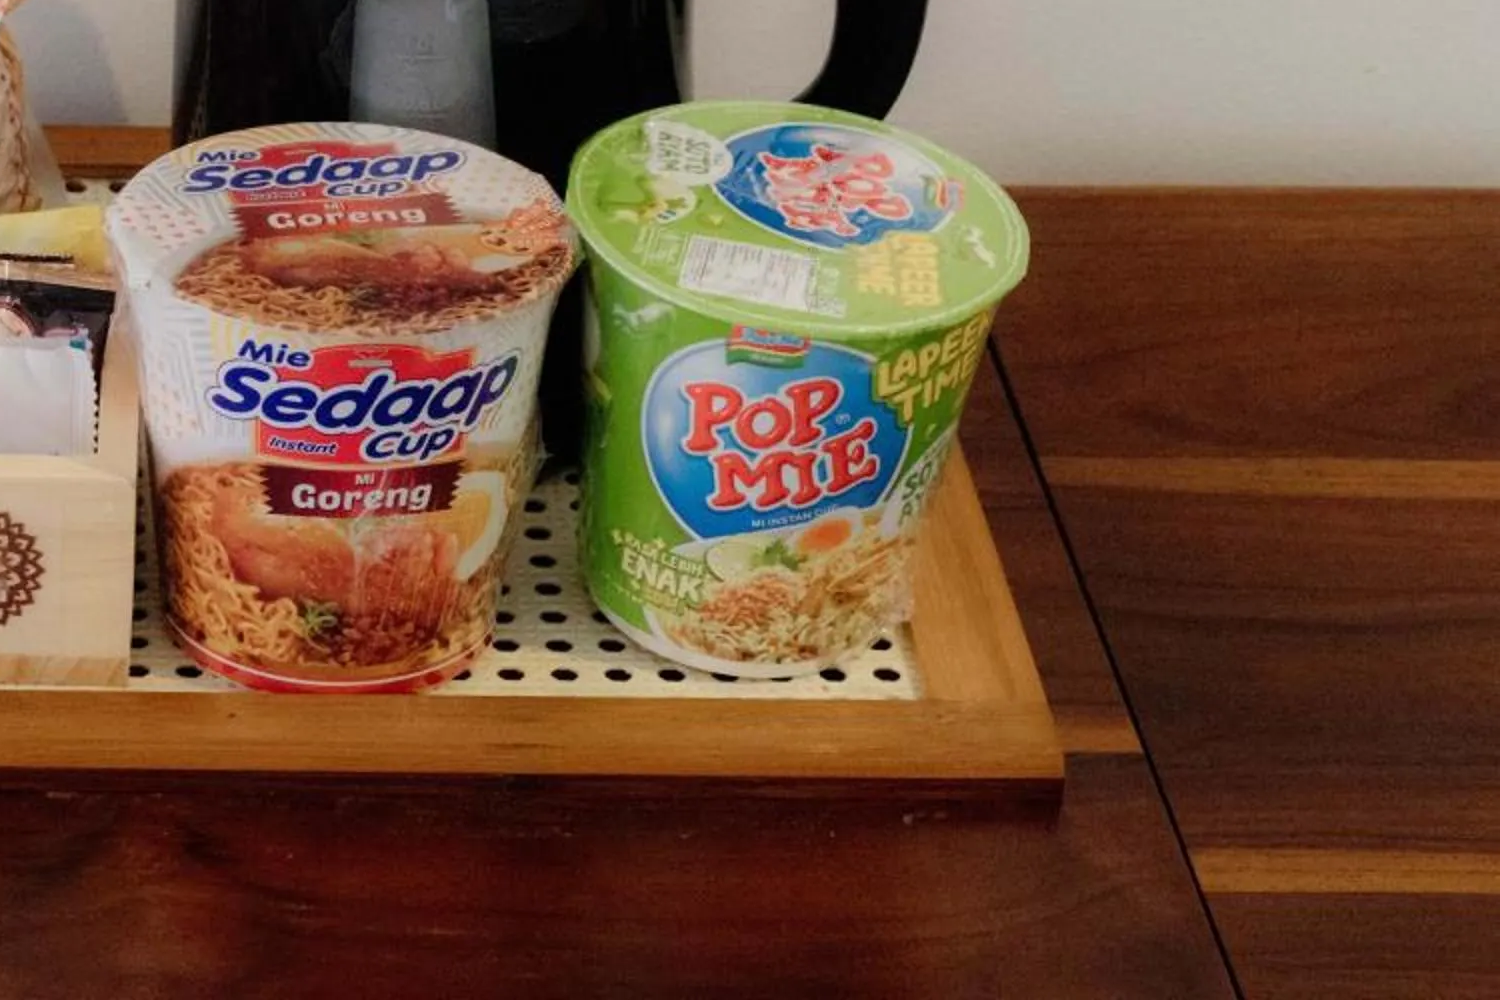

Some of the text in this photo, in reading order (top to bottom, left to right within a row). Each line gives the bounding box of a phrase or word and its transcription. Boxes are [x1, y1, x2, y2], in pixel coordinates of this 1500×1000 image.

[196, 149, 260, 164] Mie
[182, 150, 462, 194] Sedaap
[327, 181, 405, 198] Cup
[267, 206, 428, 231] Goreng
[238, 339, 312, 368] Mie
[211, 352, 519, 429] Sedaap
[364, 427, 456, 461] Cup
[708, 420, 879, 509] MIE
[355, 473, 376, 486] Mi
[290, 484, 434, 512] Goreng
[621, 546, 703, 603] ENAK
